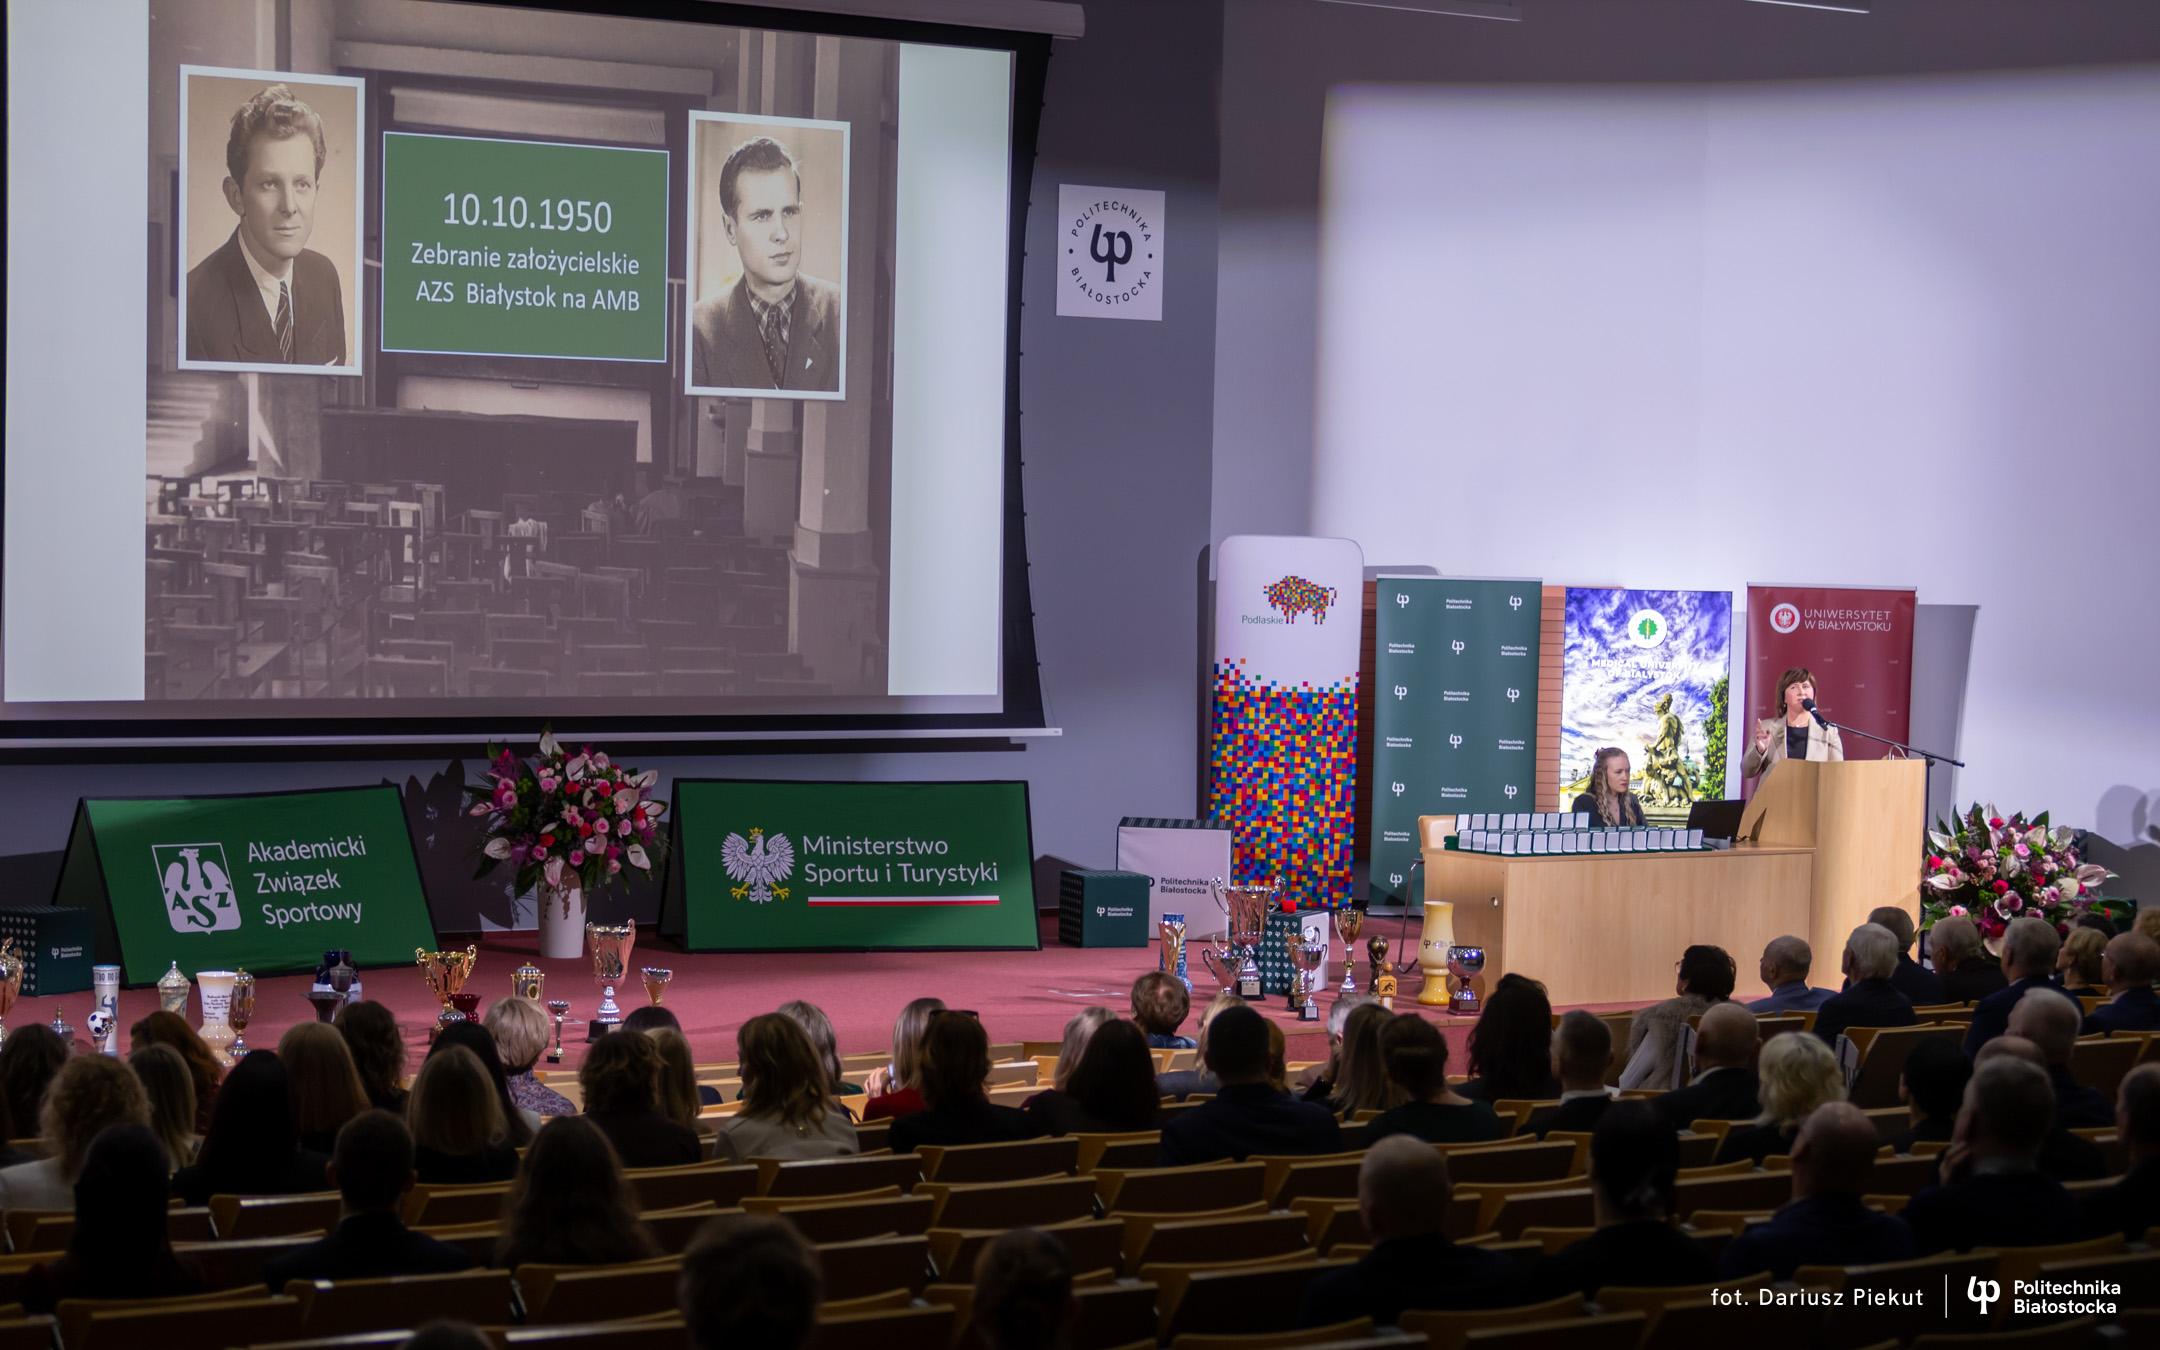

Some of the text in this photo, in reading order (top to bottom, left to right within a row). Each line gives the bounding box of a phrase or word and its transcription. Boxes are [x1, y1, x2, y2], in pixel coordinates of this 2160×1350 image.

[443, 192, 613, 234] 10.10.1950
[1071, 201, 1152, 242] POLITECHNIKA
[411, 242, 640, 276] Zebranie założycielskie
[415, 280, 640, 312] AZS Białystok na AMB
[1071, 267, 1152, 305] BIAŁOSTOCKA
[1242, 615, 1284, 625] Podlaskie
[1804, 609, 1891, 621] UNIWERSYTET
[1804, 620, 1891, 632] W BIAŁYMSTOKU
[1591, 659, 1637, 668] MEDICAL
[248, 835, 367, 863] Akademicki
[803, 835, 949, 855] Ministerstwo
[253, 868, 341, 896] Związek
[804, 862, 998, 886] Sportu i Turystyki
[1160, 877, 1209, 886] Politechnika
[1160, 886, 1207, 894] Białostocka
[262, 902, 362, 929] Sportowy
